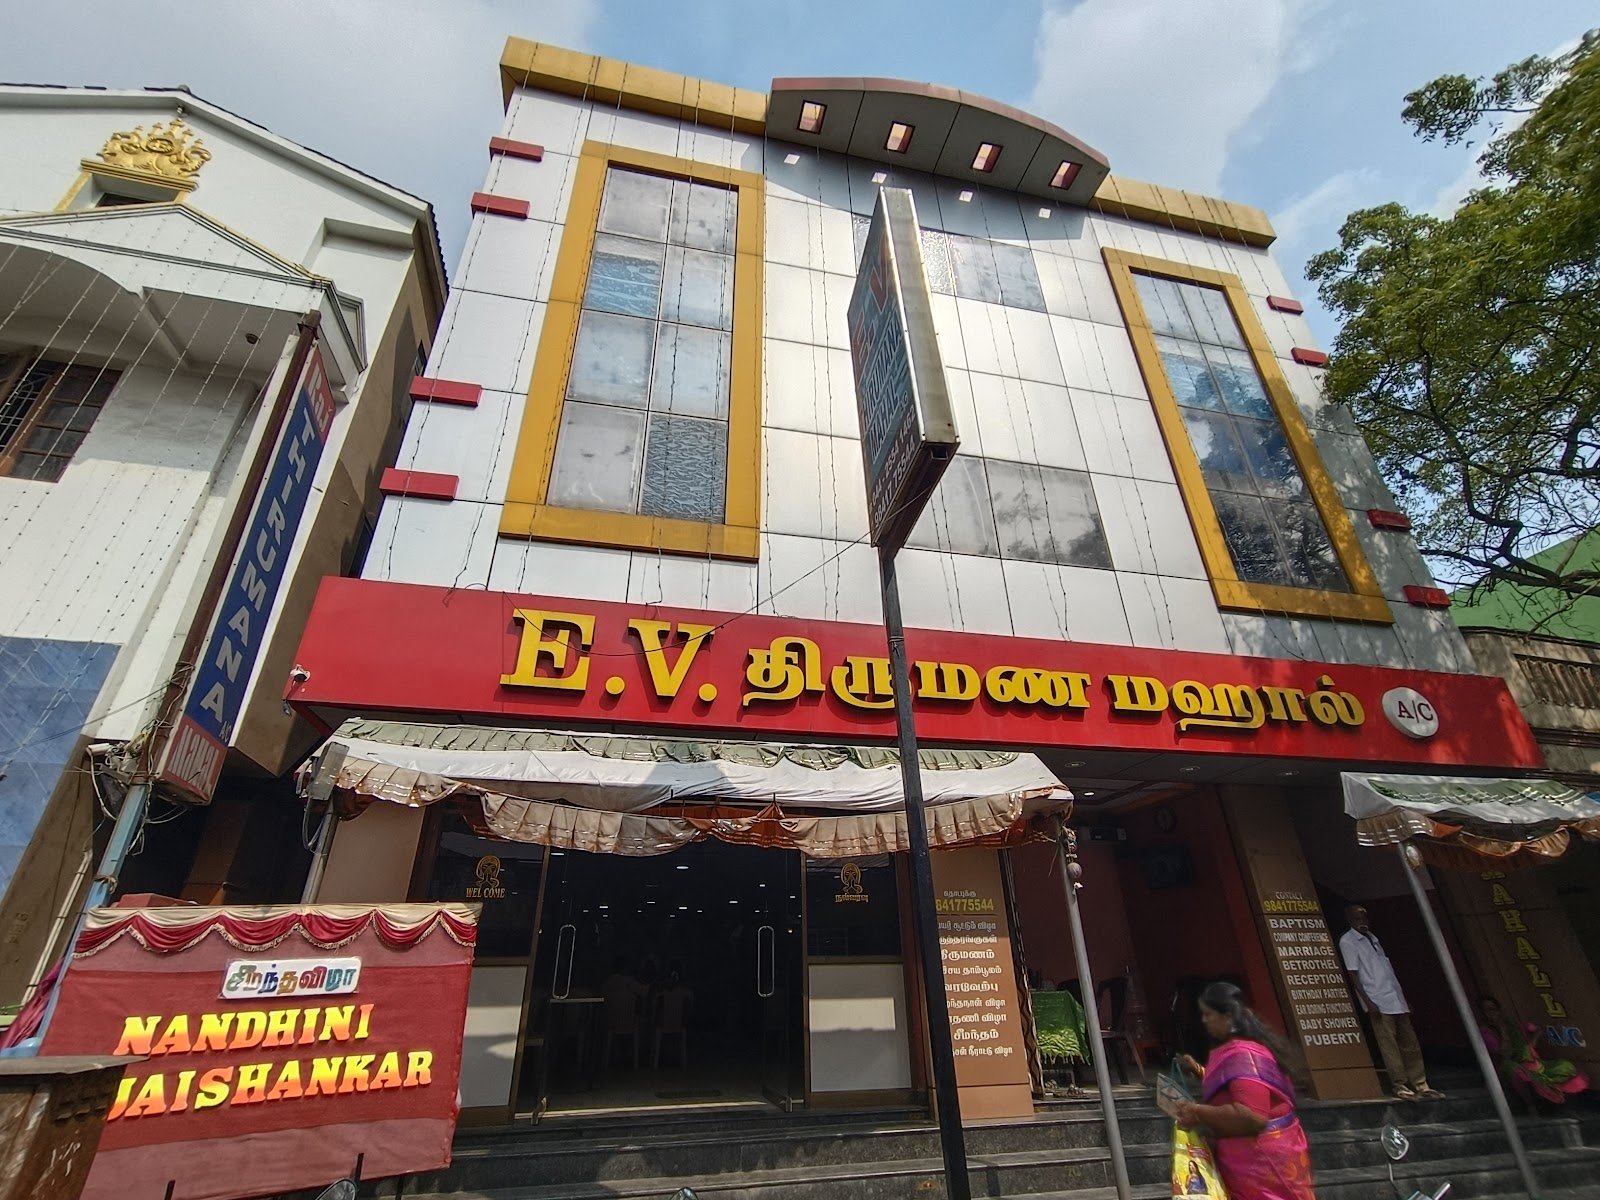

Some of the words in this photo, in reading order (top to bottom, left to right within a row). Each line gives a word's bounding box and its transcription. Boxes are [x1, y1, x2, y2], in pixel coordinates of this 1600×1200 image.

[869, 380, 900, 464] MAHAL
[874, 481, 893, 529] 98417
[893, 434, 915, 489] 75544
[199, 407, 315, 723] THIRUMANA
[499, 608, 719, 703] E.V.
[742, 636, 1091, 709] திருமண
[1107, 673, 1366, 733] மஹால்
[1395, 698, 1435, 723] A/C
[935, 899, 994, 911] 841775544
[1263, 900, 1319, 912] 9841775544
[1268, 918, 1325, 929] BAPTISM
[1273, 932, 1298, 942] COMPANY
[1297, 932, 1330, 942] CONFERENCE
[1277, 946, 1335, 957] MARRIAGE
[1282, 959, 1340, 971] BETROTHEL
[1286, 973, 1345, 986] RECEPTION
[1290, 989, 1323, 1000] BIRTHDAY
[1322, 987, 1349, 999] PARTIES
[985, 997, 1006, 1010] விழா
[1295, 1004, 1308, 1015] EAR
[1325, 1002, 1353, 1014] FUNCTIONS
[981, 1012, 1007, 1025] விழா
[1300, 1019, 1323, 1030] BABY
[1323, 1017, 1358, 1029] SHOWER
[113, 1003, 376, 1058] NANDHINI
[953, 1028, 999, 1042] சீமந்தம்
[1303, 1032, 1361, 1046] PUBERTY
[994, 1045, 1013, 1057] விழா
[107, 1050, 434, 1122] JAISHANKAR
